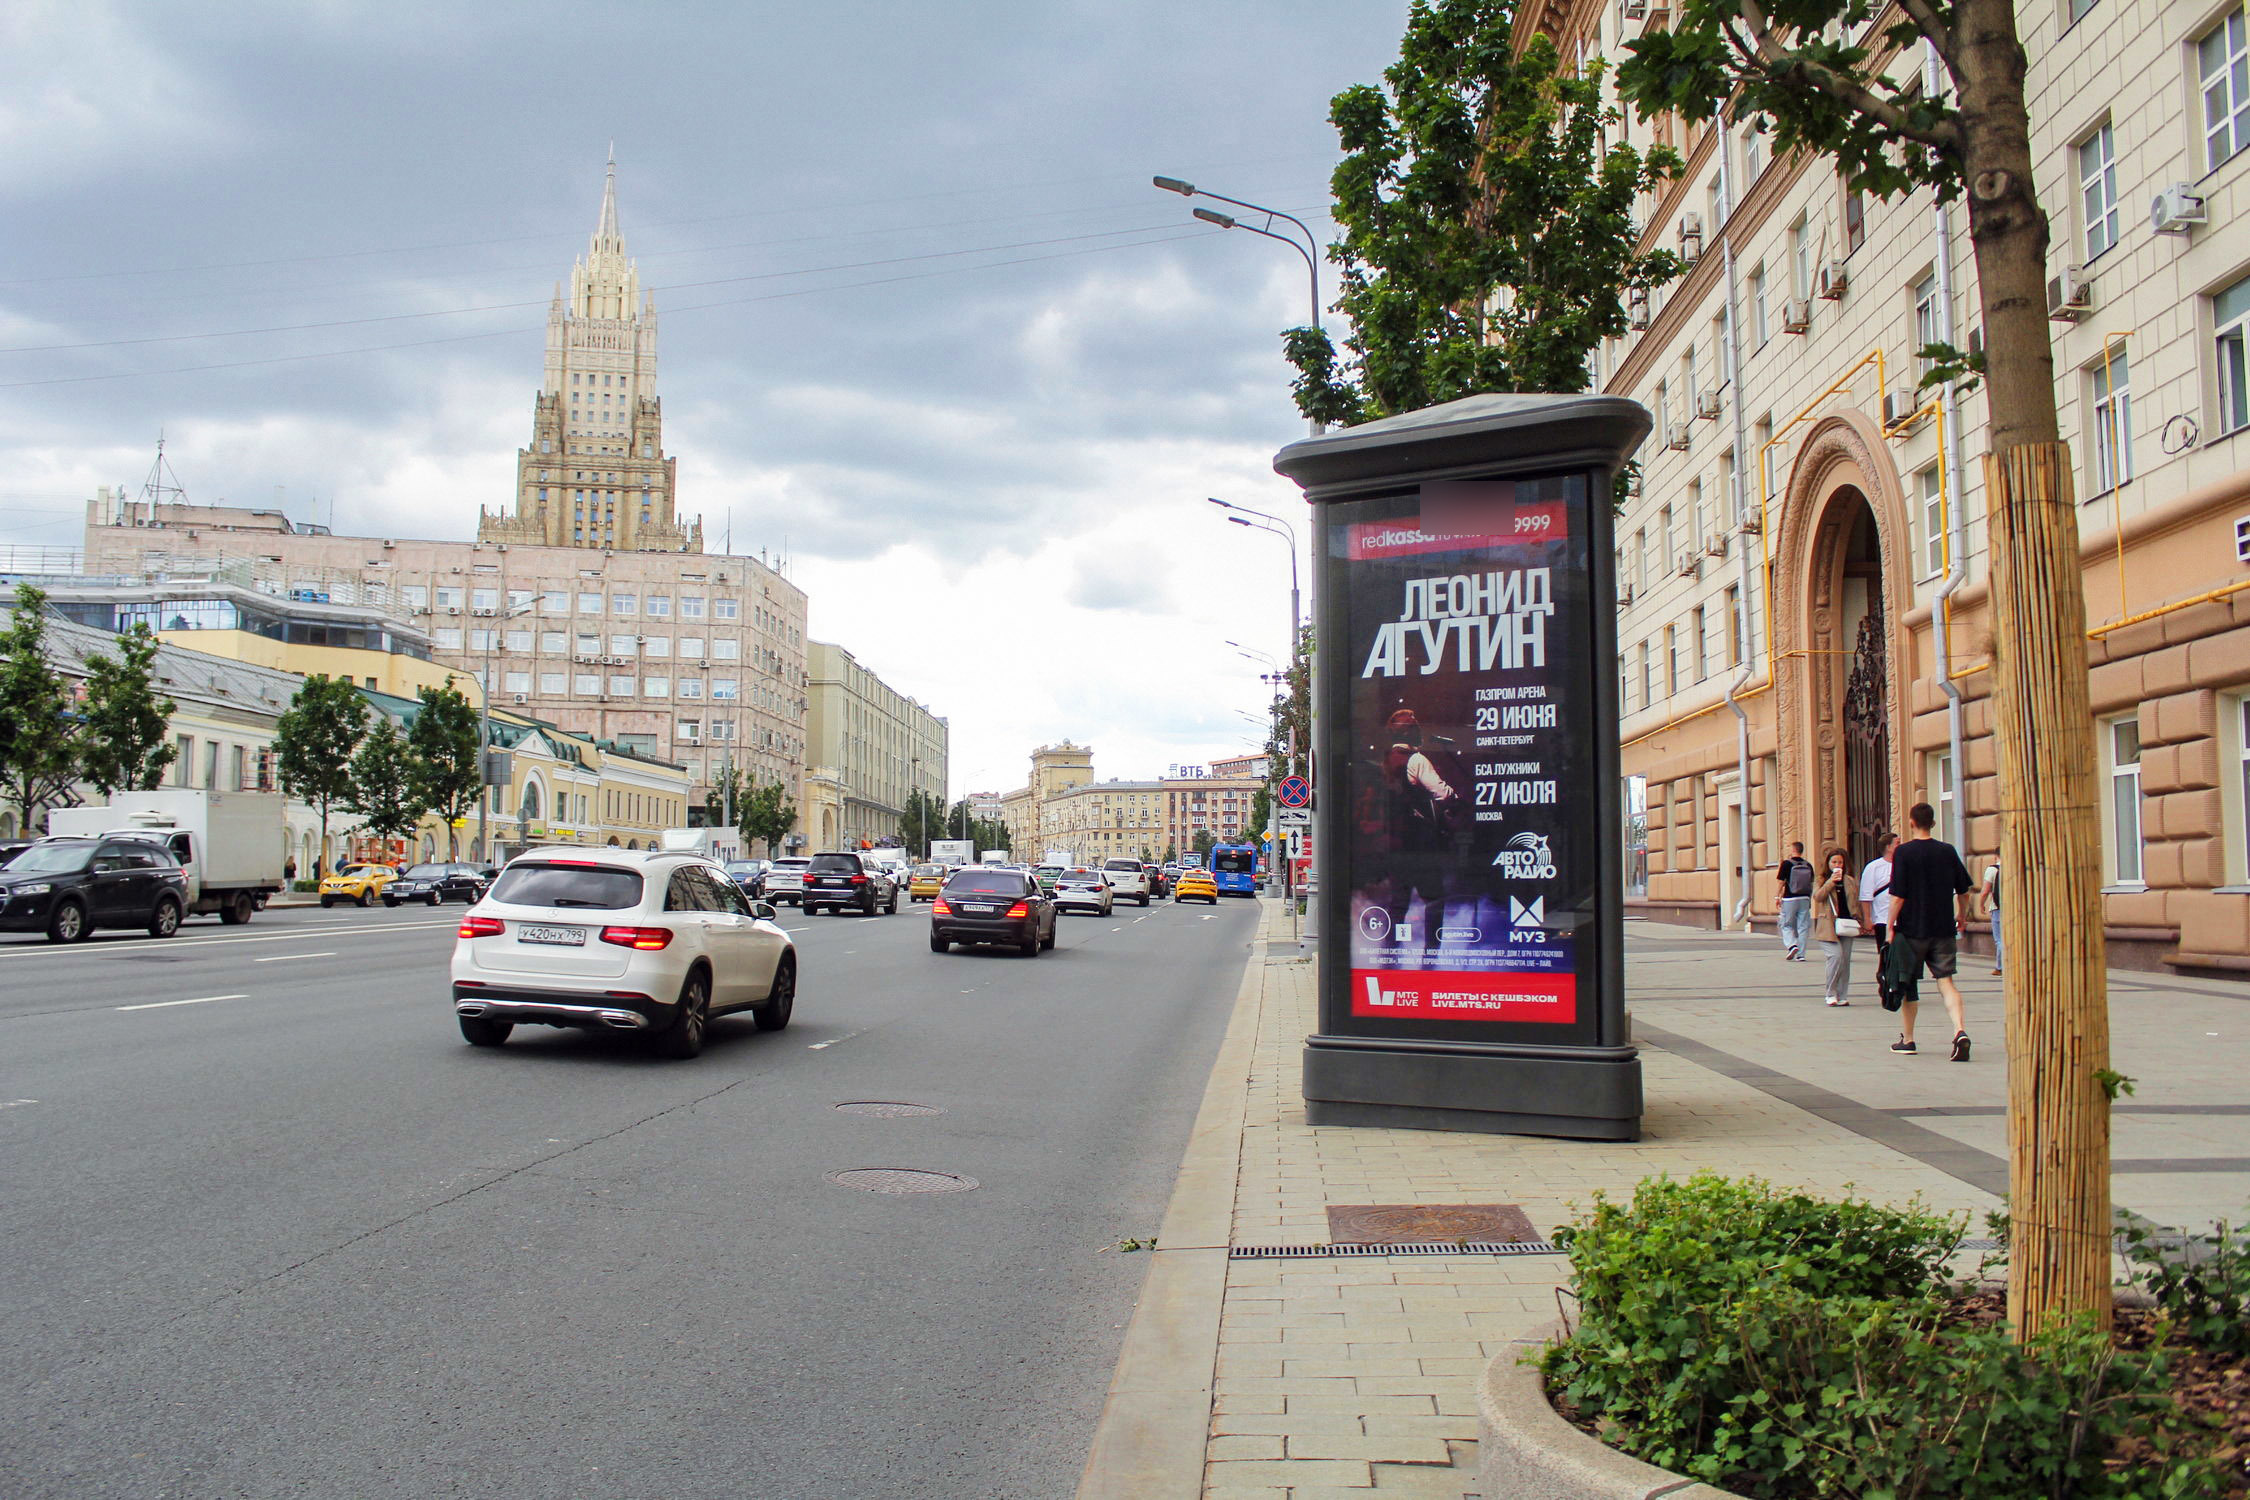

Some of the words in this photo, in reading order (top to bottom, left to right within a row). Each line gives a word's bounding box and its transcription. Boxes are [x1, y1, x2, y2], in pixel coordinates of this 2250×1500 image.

[1400, 567, 1554, 621] ЛЕОНИД
[1362, 611, 1545, 678] АГУТИН
[1475, 687, 1516, 701] ГАЗПРОМ
[1517, 685, 1547, 699] АРЕНА
[1476, 706, 1498, 731] 29
[1502, 703, 1556, 730] ИЮНЯ
[1476, 735, 1535, 746] САНКТ-ПЕТЕРБУРГ
[1180, 765, 1204, 778] ВТБ
[1475, 764, 1493, 776] БСА
[1493, 762, 1540, 776] ЛУЖНИКИ
[1475, 782, 1498, 806] 27
[1501, 780, 1557, 805] ИЮЛЯ
[1476, 811, 1504, 822] МОСКВА
[1492, 850, 1535, 866] АВТО
[1504, 864, 1557, 879] РАДИО
[1369, 917, 1383, 930] 6+
[1509, 930, 1546, 943] МУЗ
[1396, 991, 1418, 1000] МТС
[1432, 991, 1480, 1001] БИЛЕТЫ
[1481, 993, 1489, 1001] С
[1490, 993, 1558, 1003] КЕШБЭКОМ
[1396, 999, 1418, 1007] LIVE
[1432, 1000, 1501, 1009] LIVE.MTS.RU
